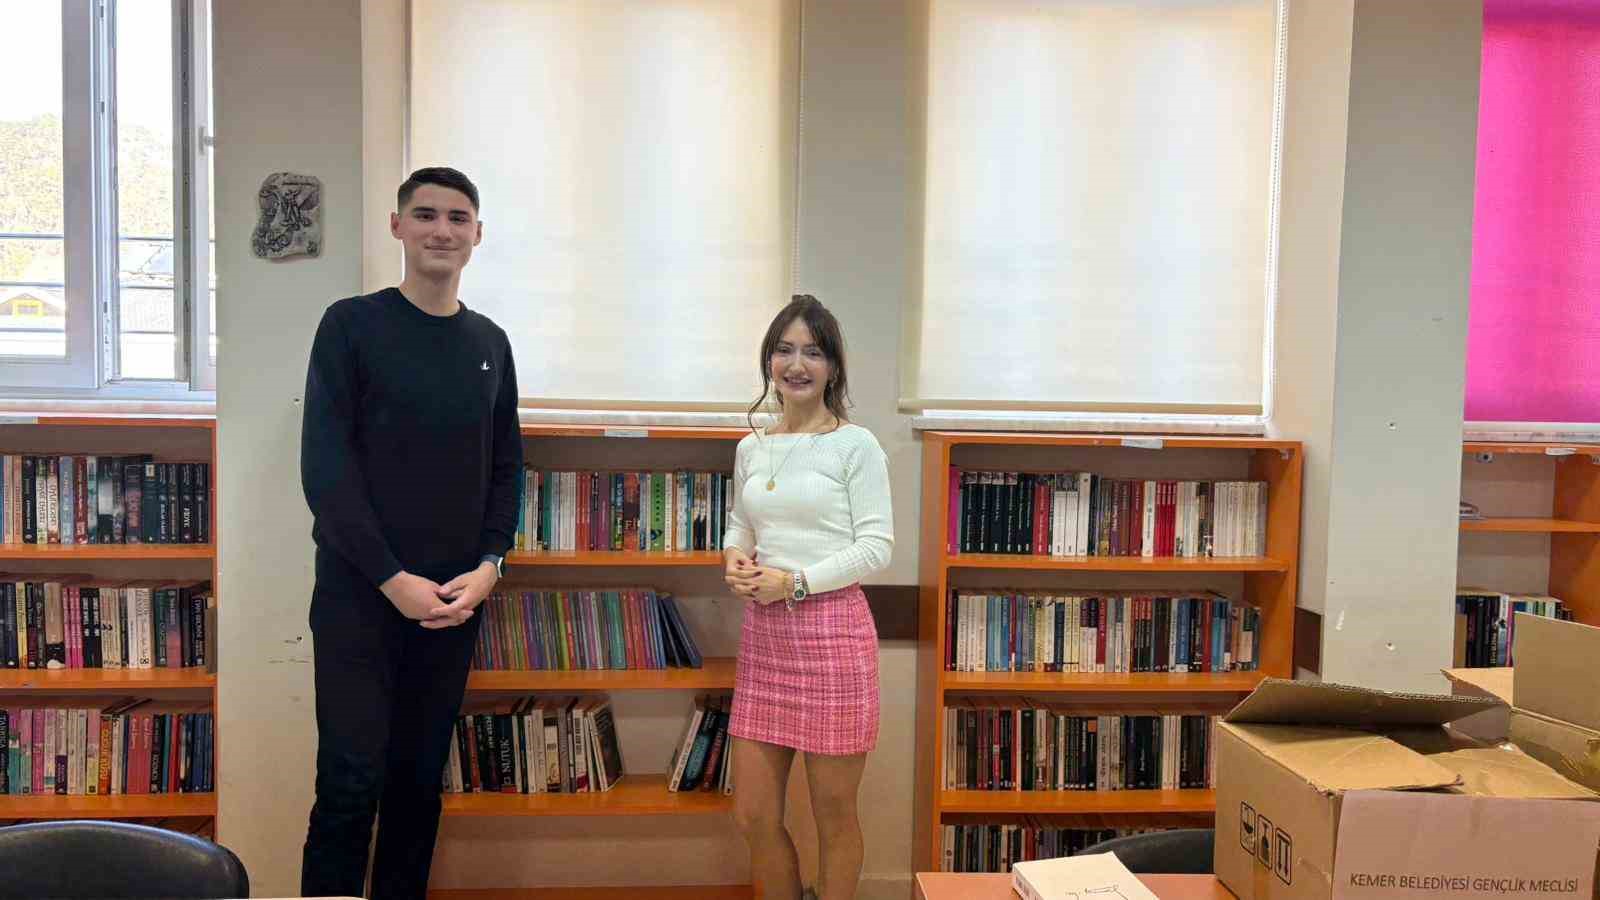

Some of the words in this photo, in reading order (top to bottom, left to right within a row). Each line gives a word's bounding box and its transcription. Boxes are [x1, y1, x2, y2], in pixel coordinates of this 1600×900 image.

[1350, 873, 1396, 888] KEMER
[1399, 874, 1470, 890] BELEDİYESİ
[1472, 877, 1526, 893] GENÇLİK
[1528, 878, 1579, 893] MECLİSİ
